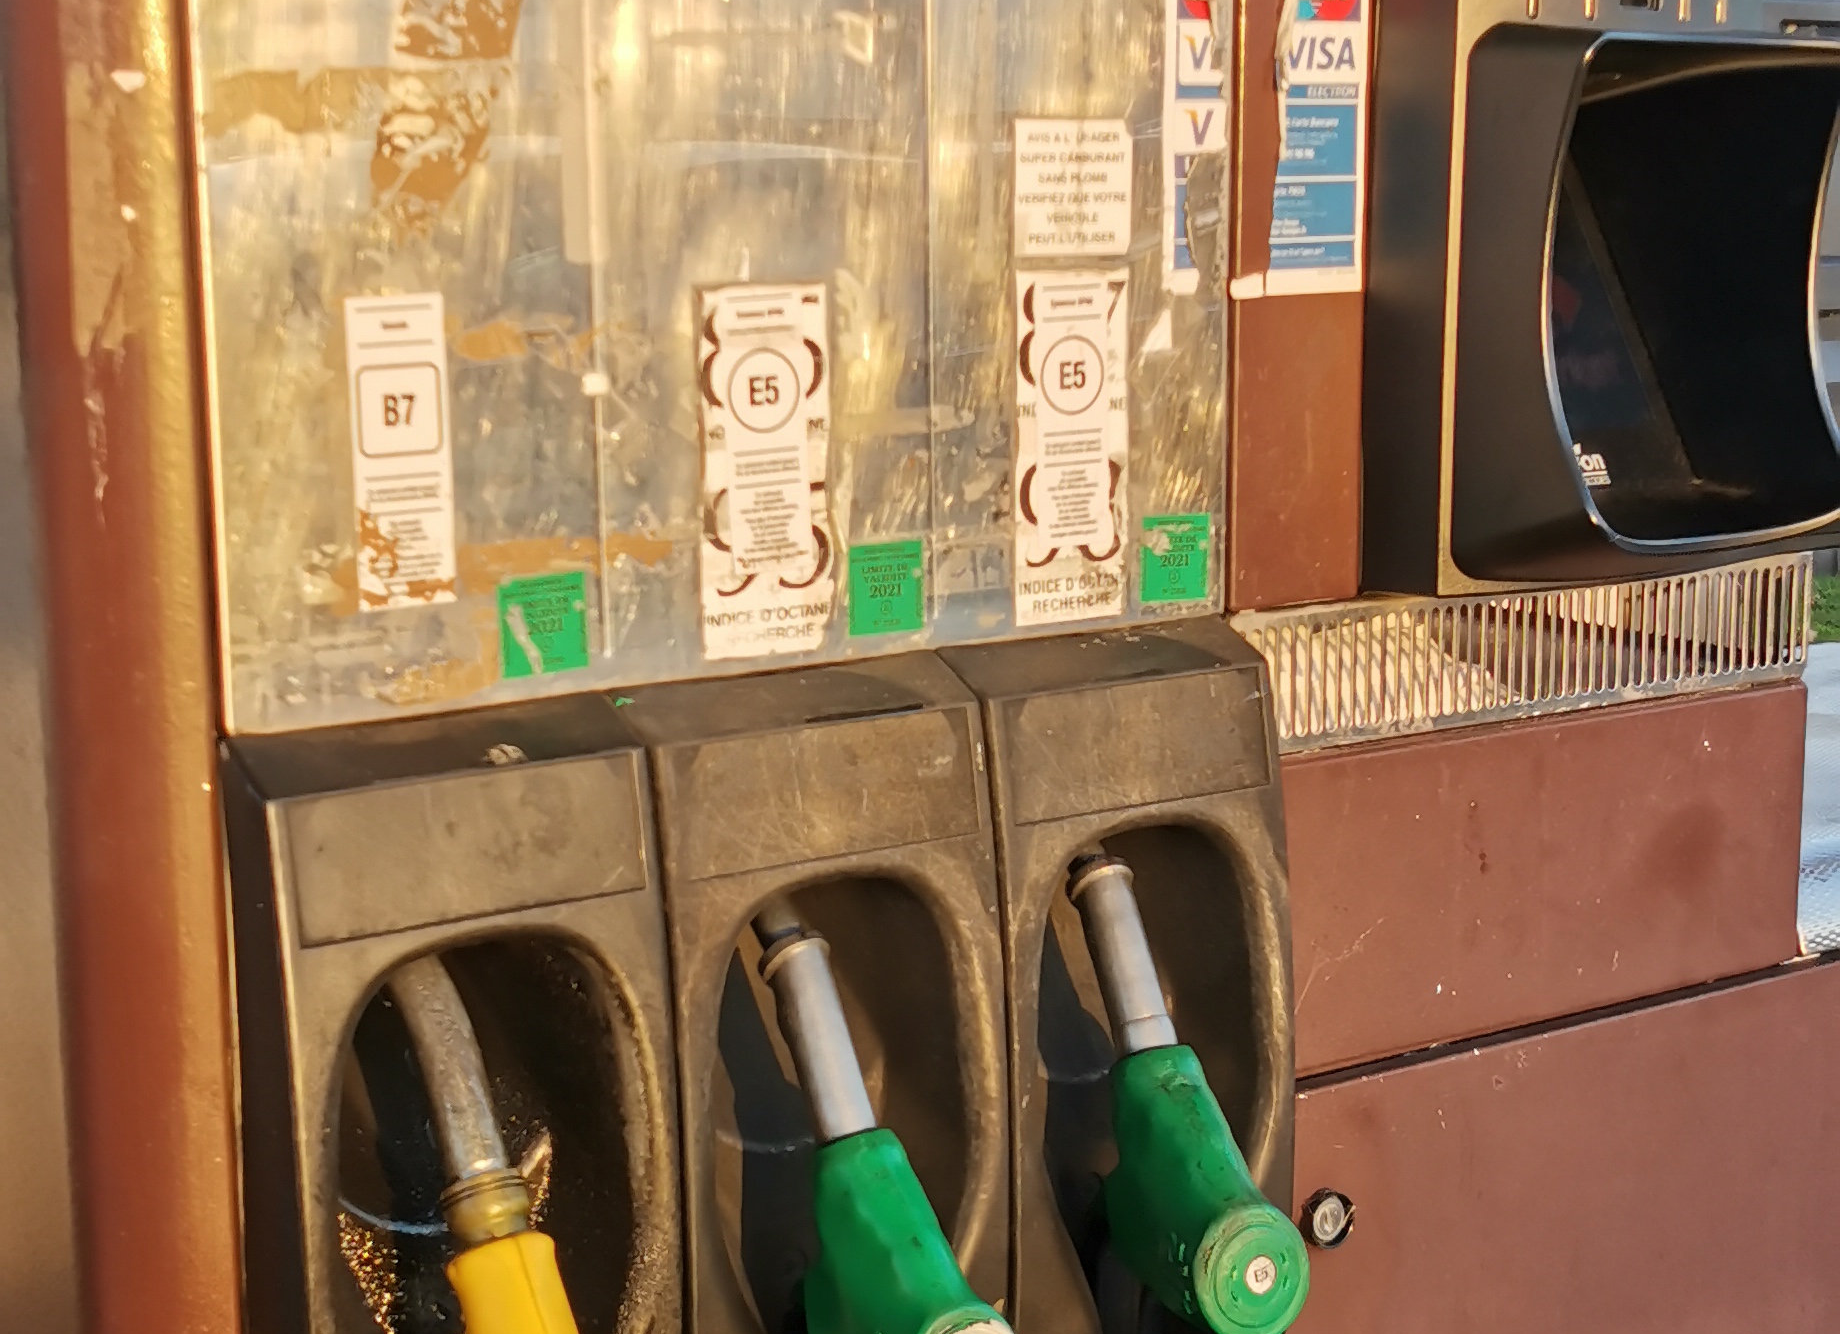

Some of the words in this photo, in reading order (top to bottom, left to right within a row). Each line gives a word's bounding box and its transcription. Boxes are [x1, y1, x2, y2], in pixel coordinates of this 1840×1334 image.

[1288, 35, 1356, 71] VISA
[1020, 152, 1056, 163] SUPER
[1059, 152, 1125, 163] CARBURANT
[1038, 172, 1067, 183] SANS
[1059, 360, 1086, 390] E5
[749, 375, 779, 407] E5
[383, 394, 416, 427] B7
[1160, 554, 1190, 568] 2021
[869, 583, 902, 599] 2021
[1018, 576, 1061, 596] INDICE
[1033, 591, 1112, 613] RECHERCHE
